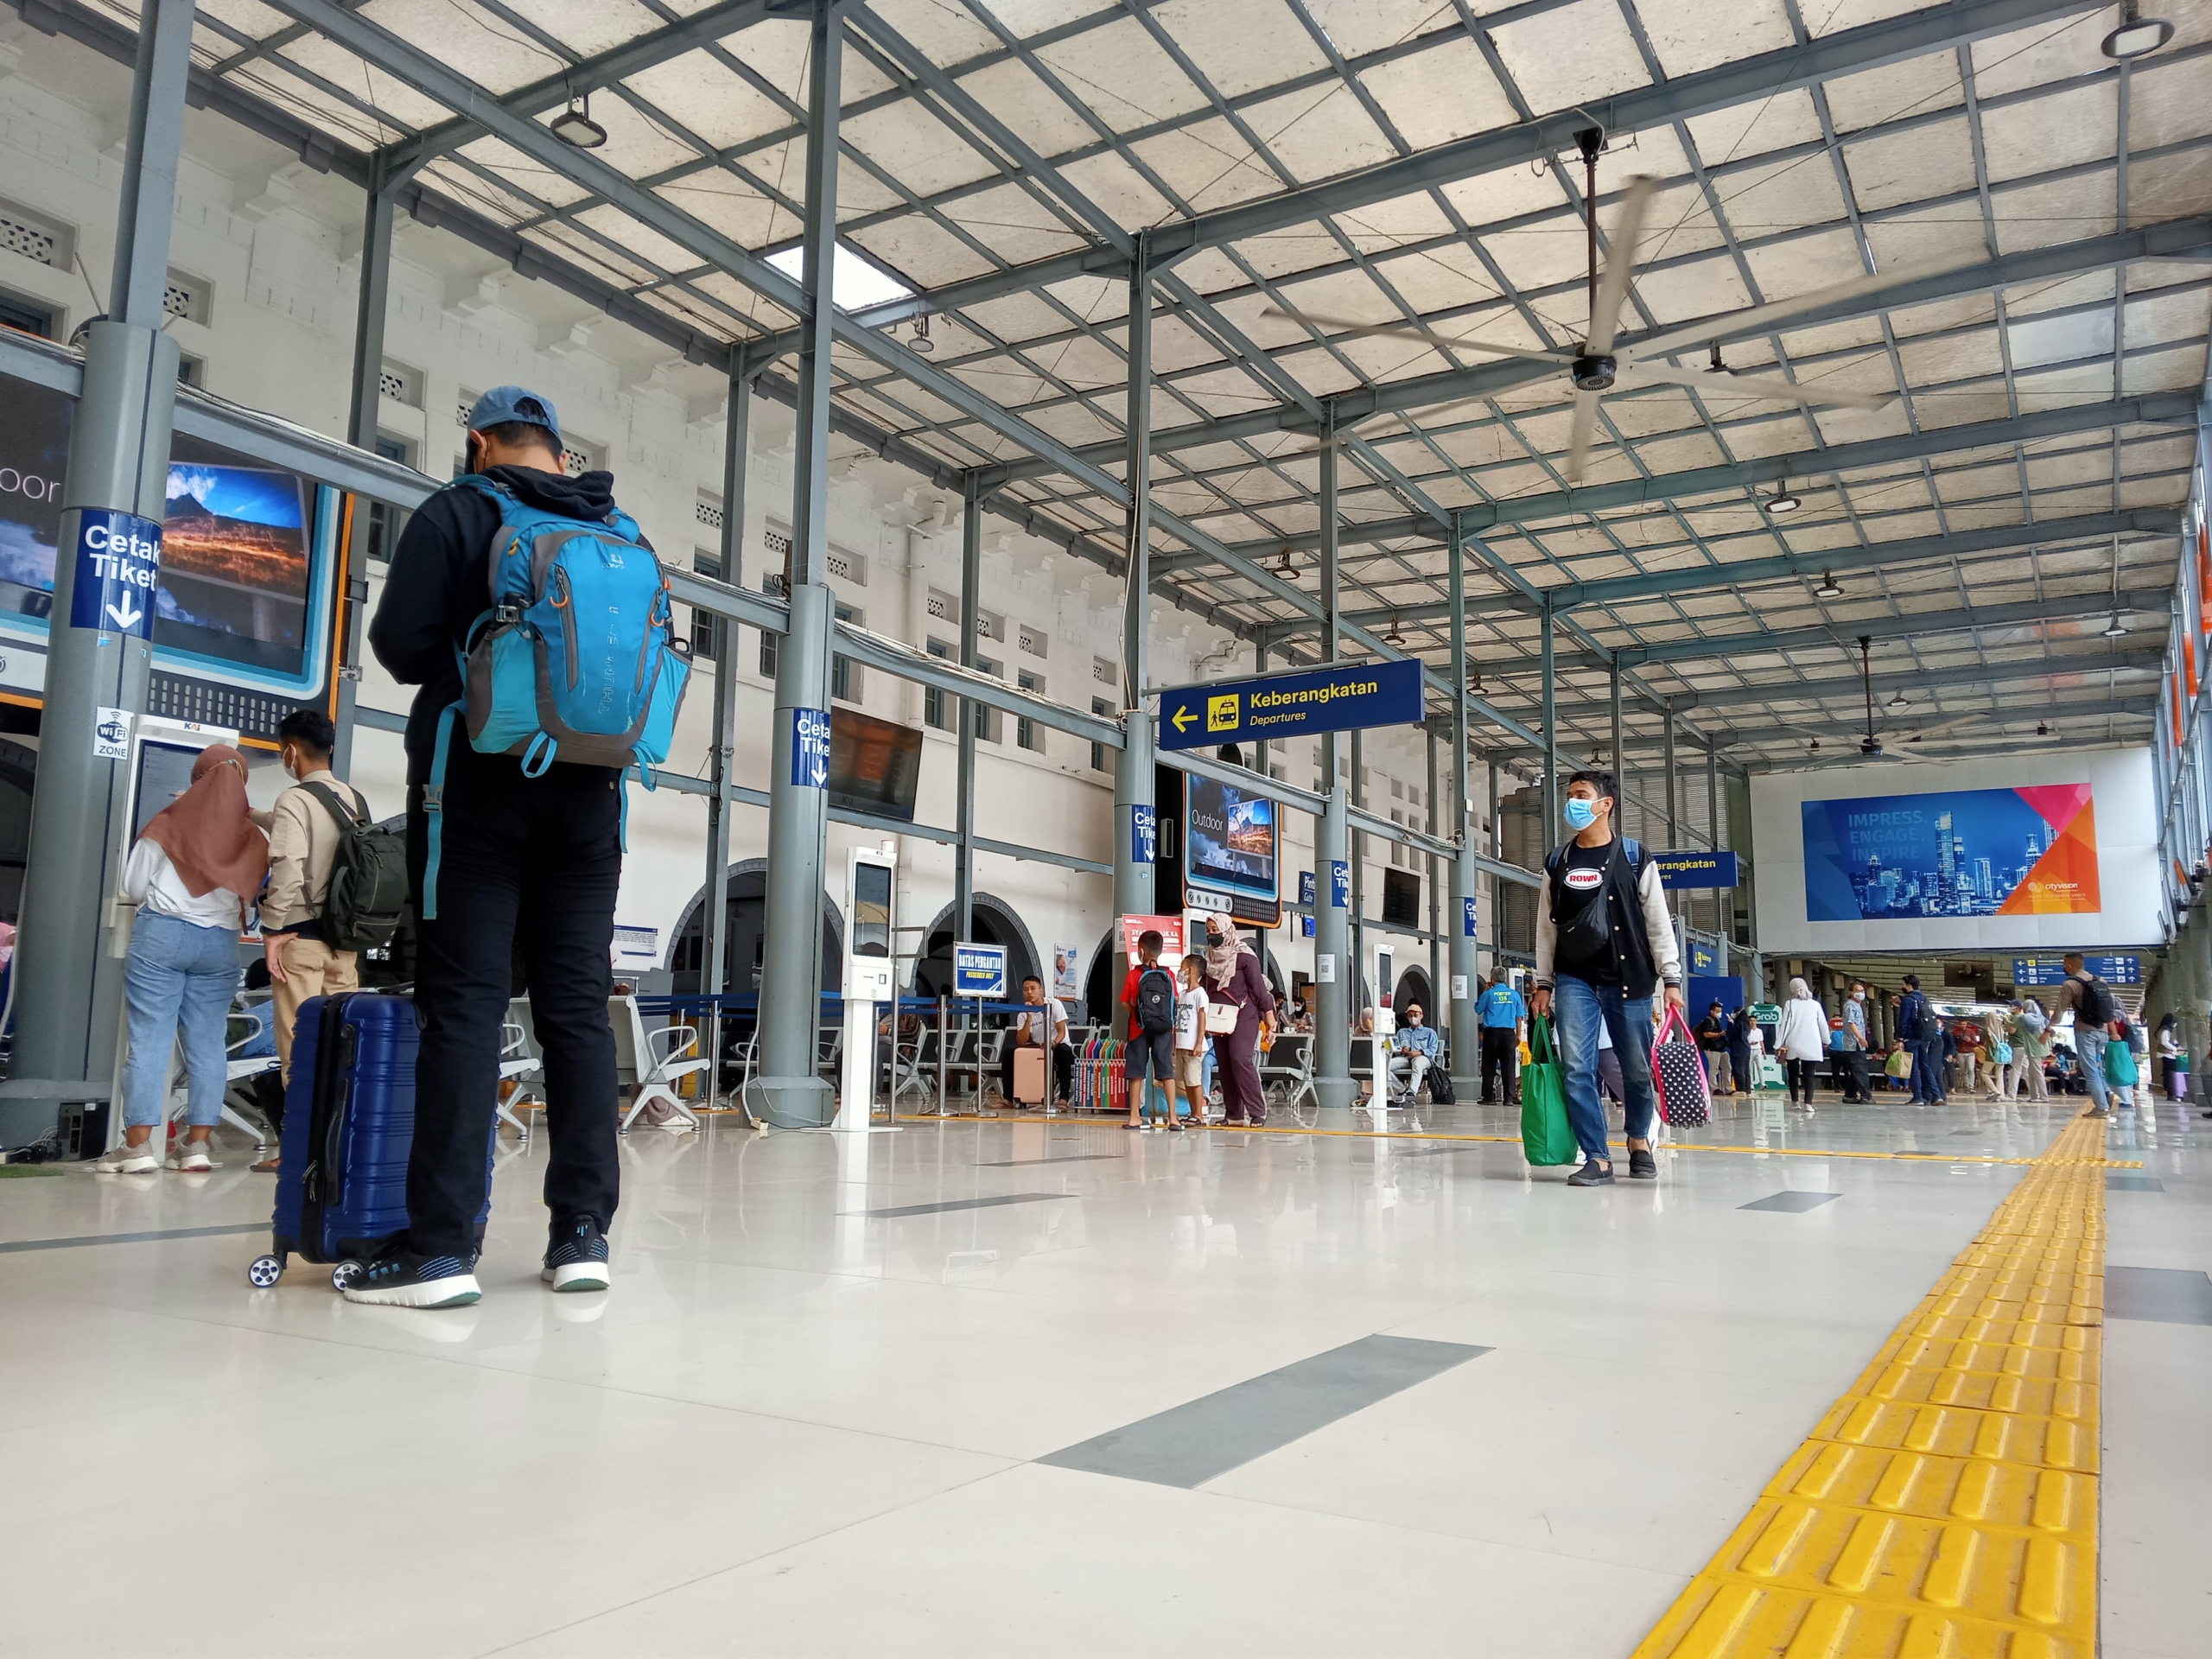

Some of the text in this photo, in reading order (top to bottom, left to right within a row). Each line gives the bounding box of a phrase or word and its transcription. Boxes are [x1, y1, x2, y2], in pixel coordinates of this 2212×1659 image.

[0, 467, 61, 503] oor
[85, 525, 161, 566] Cetak
[89, 553, 157, 592] Tiket
[1250, 681, 1377, 709] Keberangkatan
[1249, 712, 1306, 726] Departures
[797, 718, 830, 739] Ceta
[99, 745, 126, 757] ZONE
[800, 737, 830, 757] Tike
[1135, 812, 1155, 826] Ceta
[1192, 809, 1224, 831] Outdoor
[1137, 826, 1155, 840] Tike
[1656, 859, 1716, 871] erangkatan
[958, 954, 1001, 969] BATAS PENGANTAR
[1753, 1012, 1778, 1021] Grab
